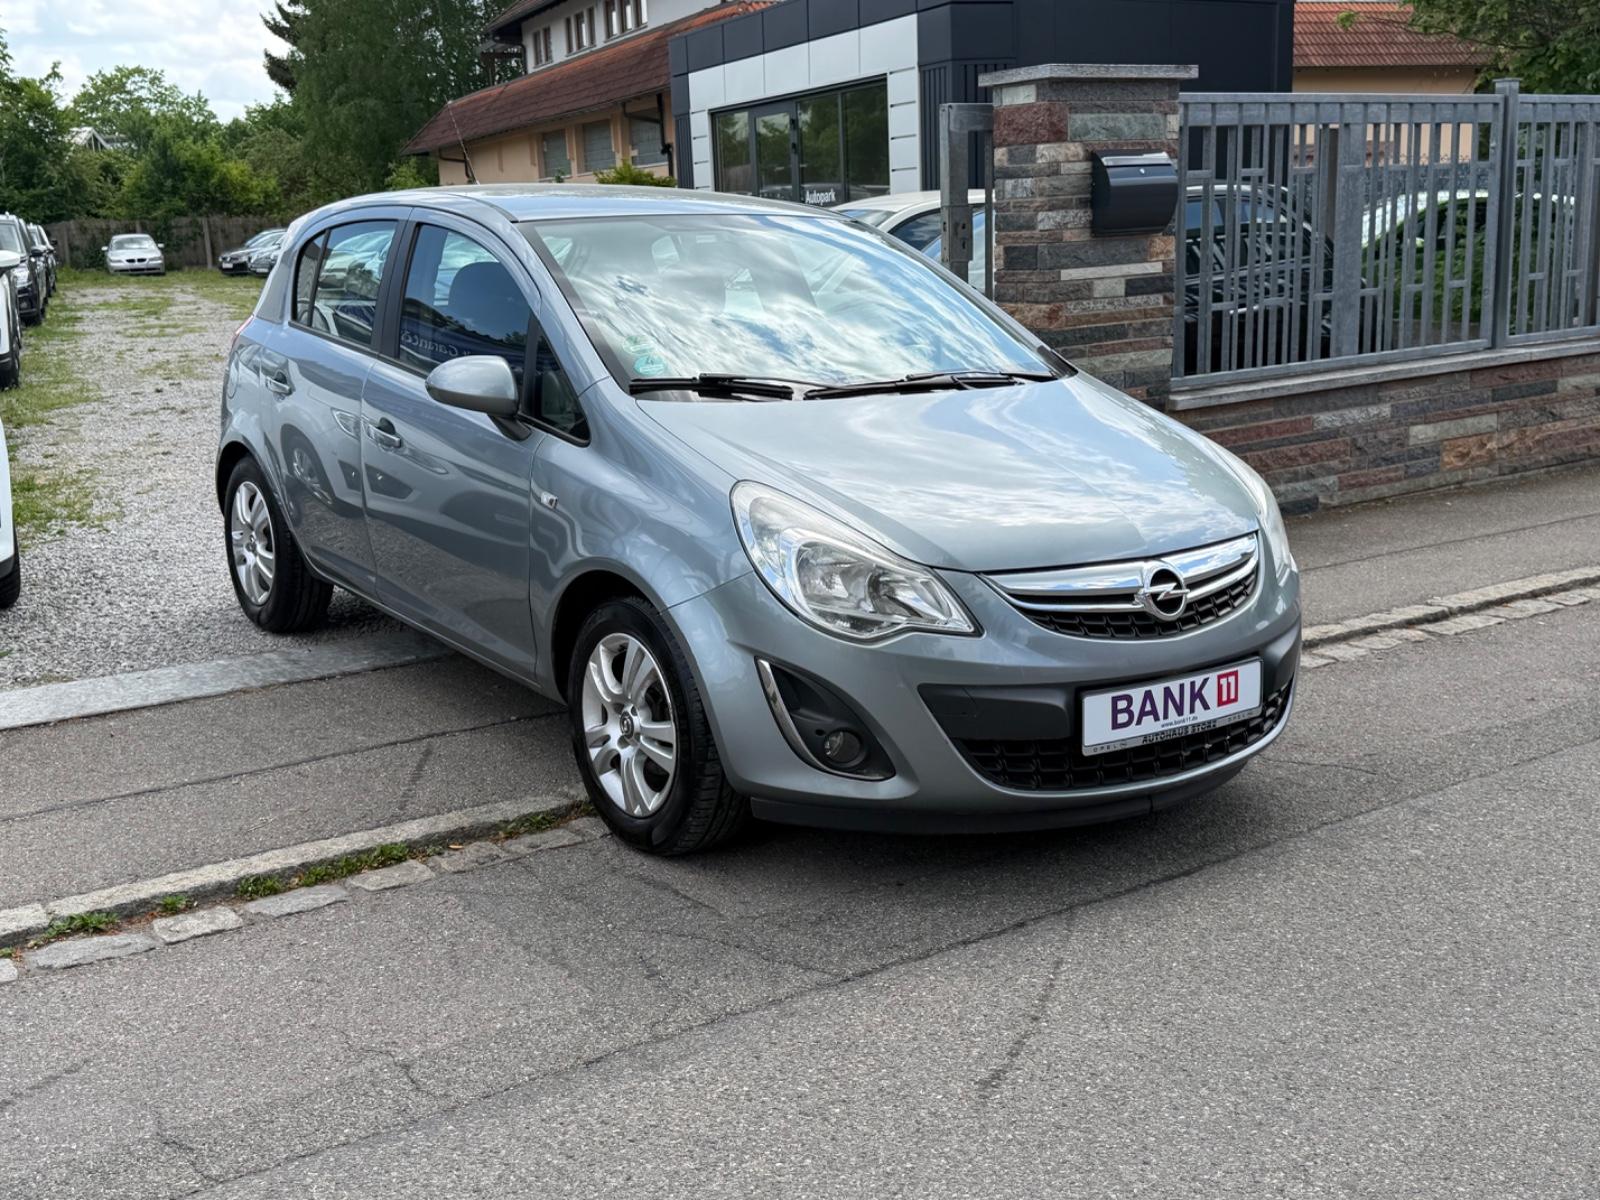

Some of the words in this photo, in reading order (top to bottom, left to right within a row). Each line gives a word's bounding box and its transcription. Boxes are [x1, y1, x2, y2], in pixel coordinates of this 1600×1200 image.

[805, 188, 836, 206] Autopark
[1111, 677, 1211, 731] BANK
[1219, 673, 1237, 704] 11
[1142, 727, 1189, 745] AUTOHAUS
[1093, 743, 1117, 753] OPEL
